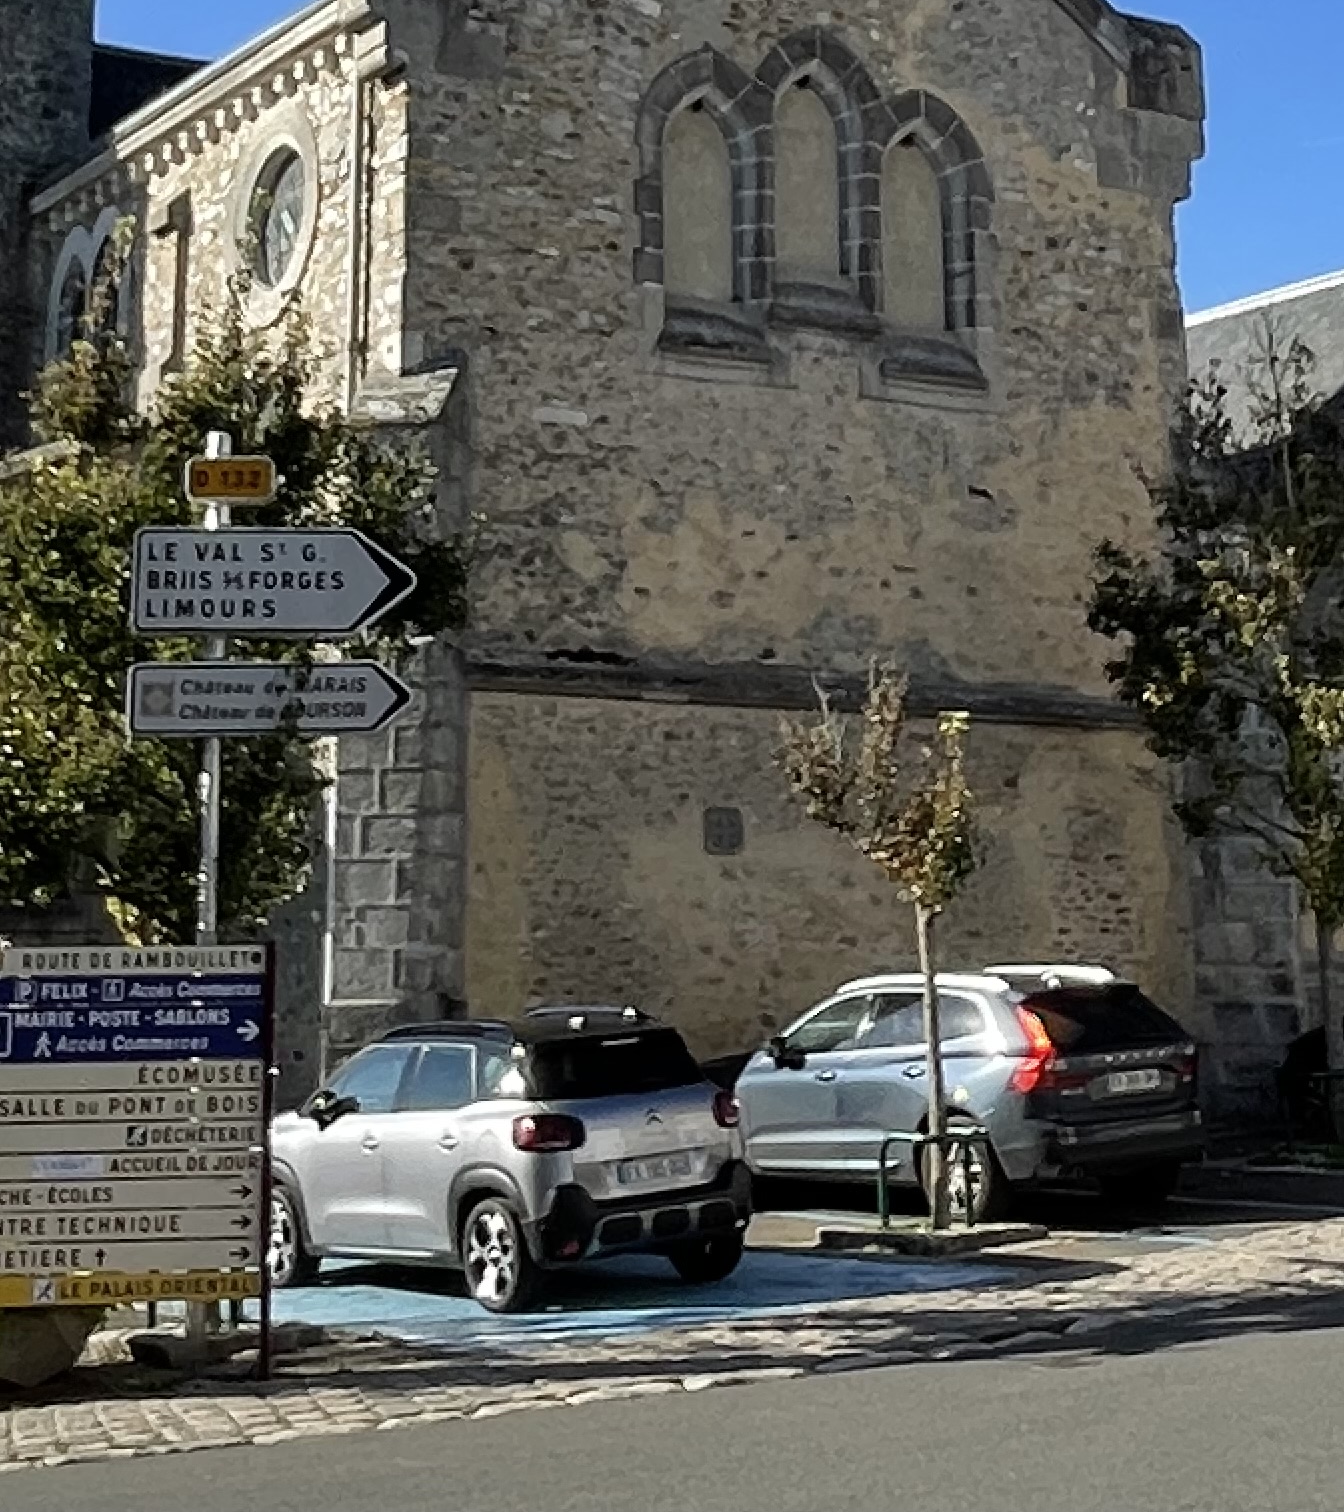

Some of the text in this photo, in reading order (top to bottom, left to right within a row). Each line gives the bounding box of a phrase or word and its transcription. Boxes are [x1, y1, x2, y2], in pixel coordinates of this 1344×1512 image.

[196, 470, 209, 488] D
[147, 542, 179, 563] LE
[194, 542, 245, 563] VAL
[146, 570, 213, 590] BRIIS
[248, 570, 346, 590] FORGES
[145, 598, 278, 619] LIMOURS
[294, 676, 368, 694] ARAIS
[22, 951, 248, 969] ROUTE DE RAMBOUILLET
[15, 1011, 75, 1028] MAIRIE
[88, 1010, 140, 1028] POSTE
[154, 1008, 230, 1026] SABLONS
[138, 1063, 260, 1084] ÉCOMUSÉE
[108, 1096, 165, 1116] PONT
[206, 1094, 259, 1114] BOIS
[109, 1156, 182, 1173] ACCUEIL
[186, 1156, 208, 1172] DE
[213, 1154, 259, 1171] JOUR
[56, 1215, 182, 1236] TECHNIQUE
[60, 1281, 82, 1300] LE
[89, 1279, 155, 1298] PALAIS
